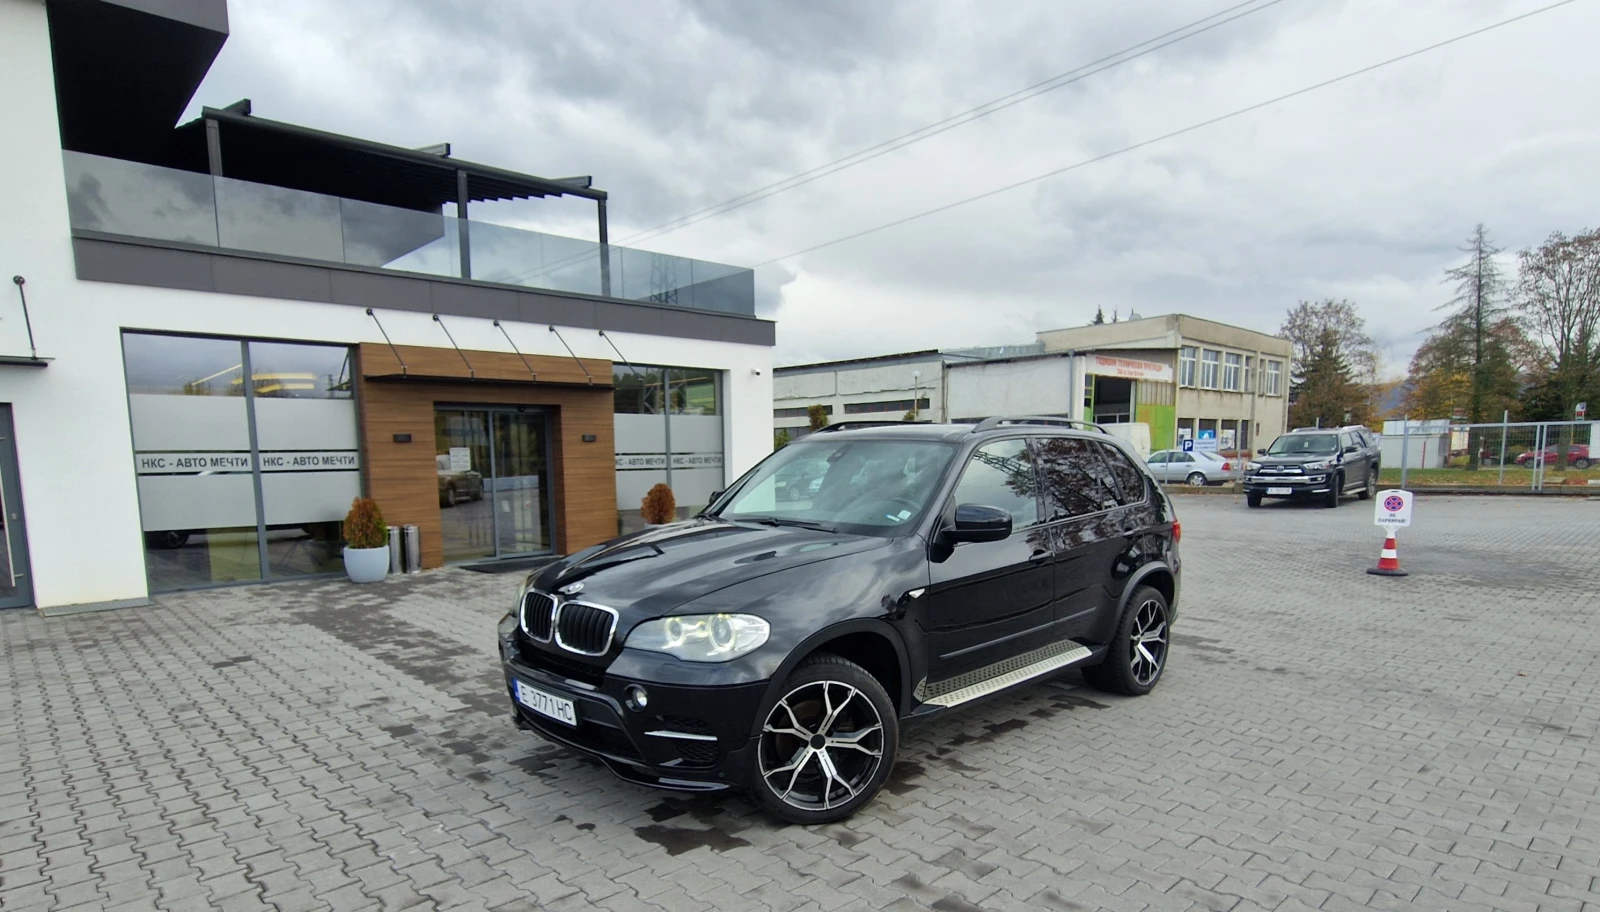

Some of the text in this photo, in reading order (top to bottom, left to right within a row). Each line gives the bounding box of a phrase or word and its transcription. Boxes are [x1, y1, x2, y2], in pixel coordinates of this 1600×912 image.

[141, 458, 166, 469] НКС
[176, 457, 208, 468] АВТО
[210, 457, 248, 468] МЕЧТИ
[263, 456, 284, 467] НКС
[292, 456, 319, 466] АВТО
[322, 456, 355, 466] МЕЧТИ
[628, 458, 645, 466] АВТО
[645, 458, 665, 466] МЕЧТИ
[673, 457, 684, 465] НКС
[689, 457, 703, 465] АВТО
[704, 456, 722, 464] МЕЧТИ
[520, 685, 529, 703] E
